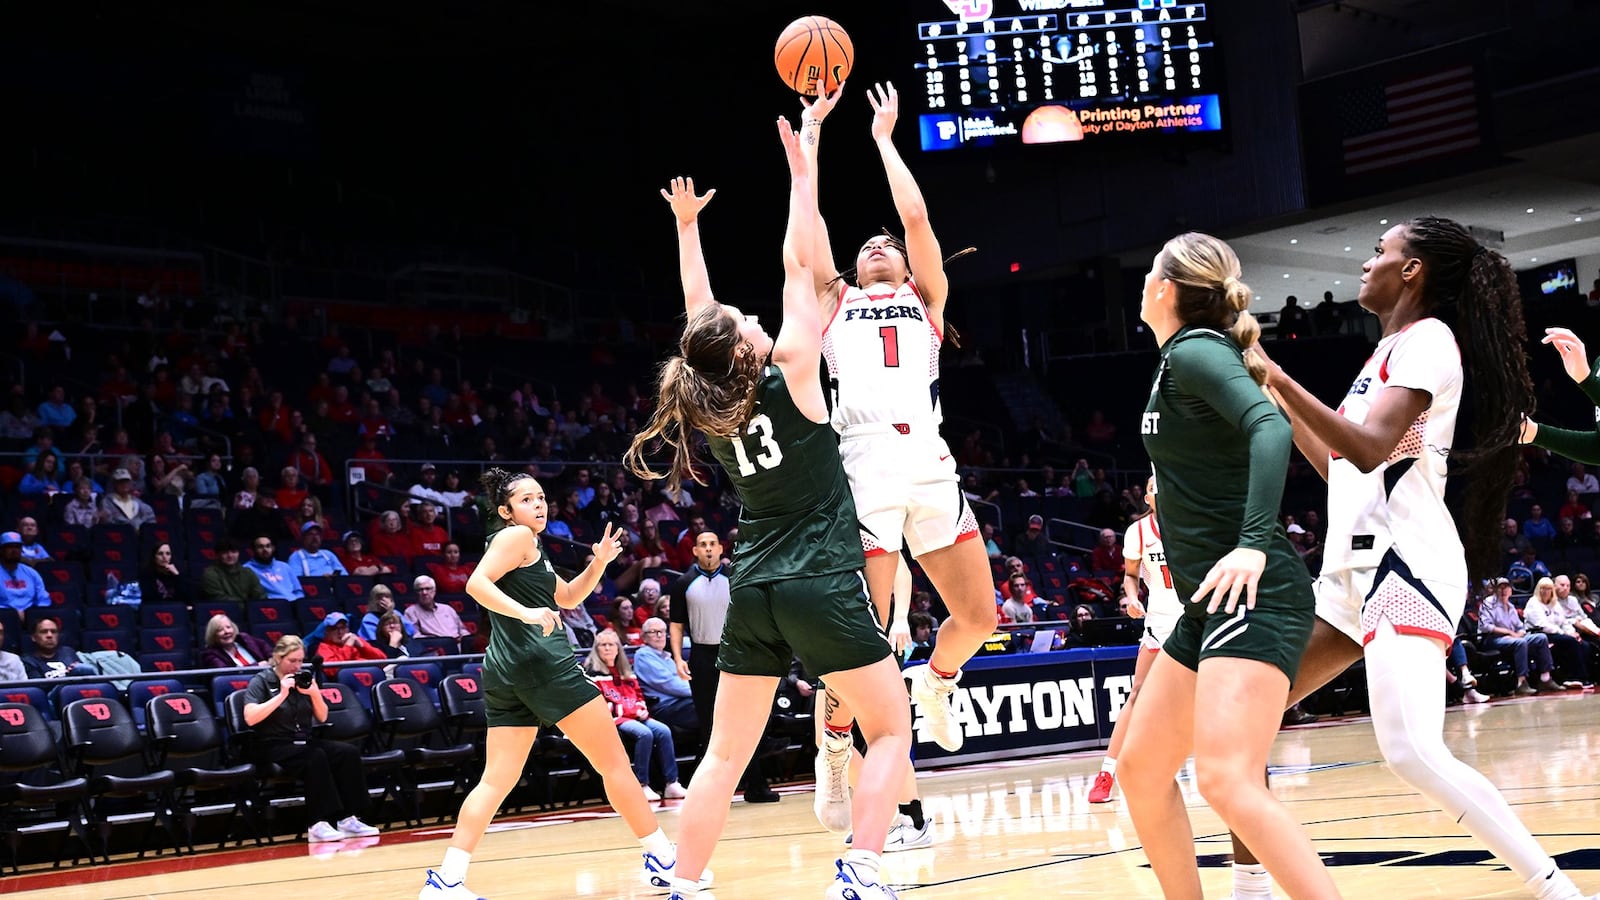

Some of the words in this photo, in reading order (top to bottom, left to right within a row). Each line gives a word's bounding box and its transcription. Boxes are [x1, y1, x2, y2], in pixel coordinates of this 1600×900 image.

[1105, 12, 1116, 24] P
[1159, 8, 1171, 20] A
[1186, 6, 1196, 19] F
[956, 22, 968, 34] P
[1011, 19, 1023, 31] A
[1038, 17, 1048, 29] F
[1161, 27, 1171, 38] 0
[1187, 25, 1195, 36] 1
[926, 44, 935, 55] 1
[957, 42, 966, 52] 7
[985, 40, 995, 51] 0
[1013, 38, 1023, 48] 0
[1136, 42, 1146, 53] 0
[1163, 40, 1171, 51] 1
[1188, 38, 1198, 49] 0
[1014, 51, 1022, 61] 1
[1078, 59, 1092, 71] 11
[1137, 56, 1145, 67] 1
[1164, 54, 1172, 65] 1
[1190, 52, 1199, 63] 0
[927, 71, 943, 83] 10
[1015, 64, 1024, 75] 1
[1043, 62, 1052, 73] 0
[1110, 70, 1118, 81] 1
[1138, 68, 1148, 79] 0
[1165, 66, 1174, 78] 0
[1191, 64, 1200, 75] 0
[960, 81, 970, 92] 0
[989, 79, 999, 90] 0
[1016, 77, 1026, 88] 0
[1044, 75, 1052, 86] 1
[1111, 83, 1119, 94] 1
[1192, 77, 1200, 88] 1
[928, 96, 945, 108] 14
[990, 92, 998, 103] 1
[1045, 88, 1053, 99] 1
[1080, 108, 1140, 122] Printing
[1144, 104, 1201, 117] Partner
[1103, 122, 1113, 131] of
[1116, 120, 1154, 132] Dayton
[1156, 116, 1202, 128] Athletics
[845, 306, 923, 322] FLYERS
[879, 326, 899, 368] 1
[729, 414, 784, 478] 13
